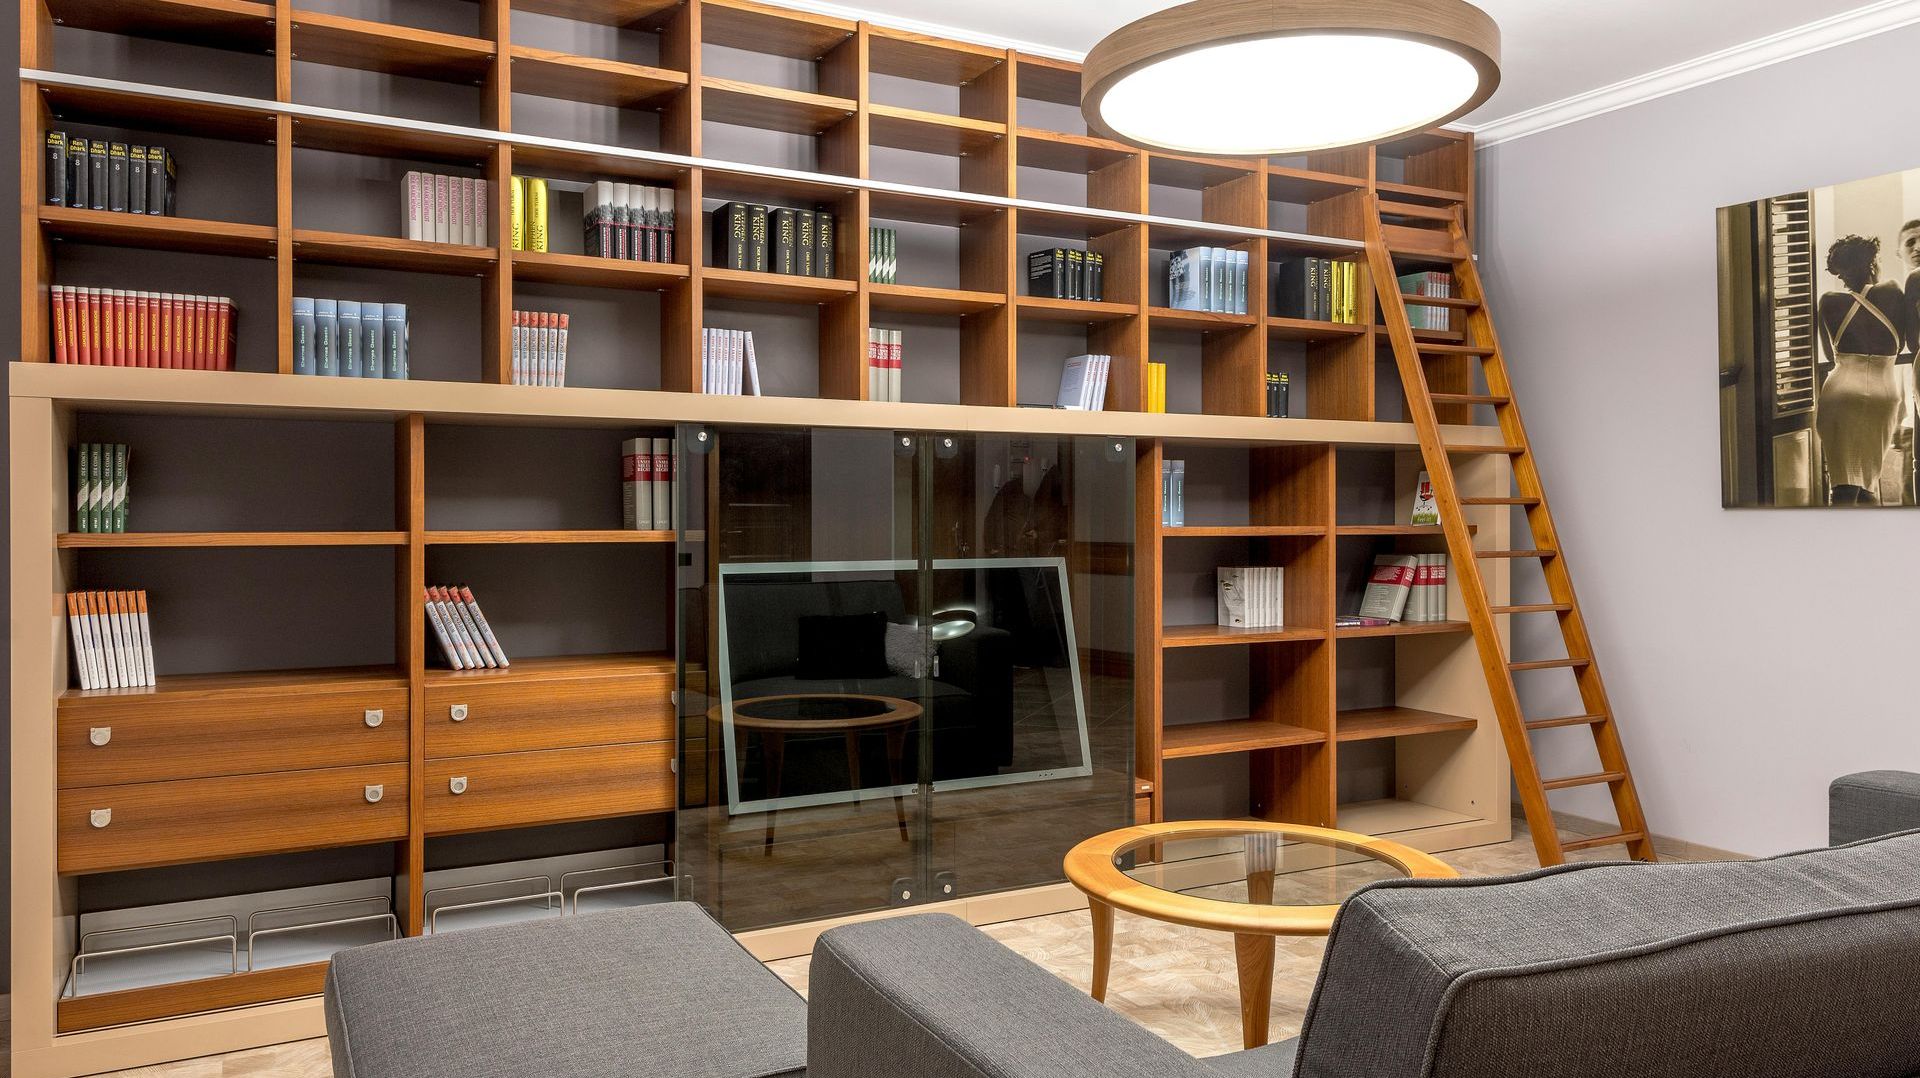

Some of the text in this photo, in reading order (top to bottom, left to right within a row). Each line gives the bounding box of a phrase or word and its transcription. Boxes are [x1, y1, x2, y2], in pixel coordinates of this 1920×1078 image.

[536, 225, 544, 250] KING
[782, 220, 790, 244] KING
[802, 222, 810, 246] KING
[821, 224, 829, 248] KING
